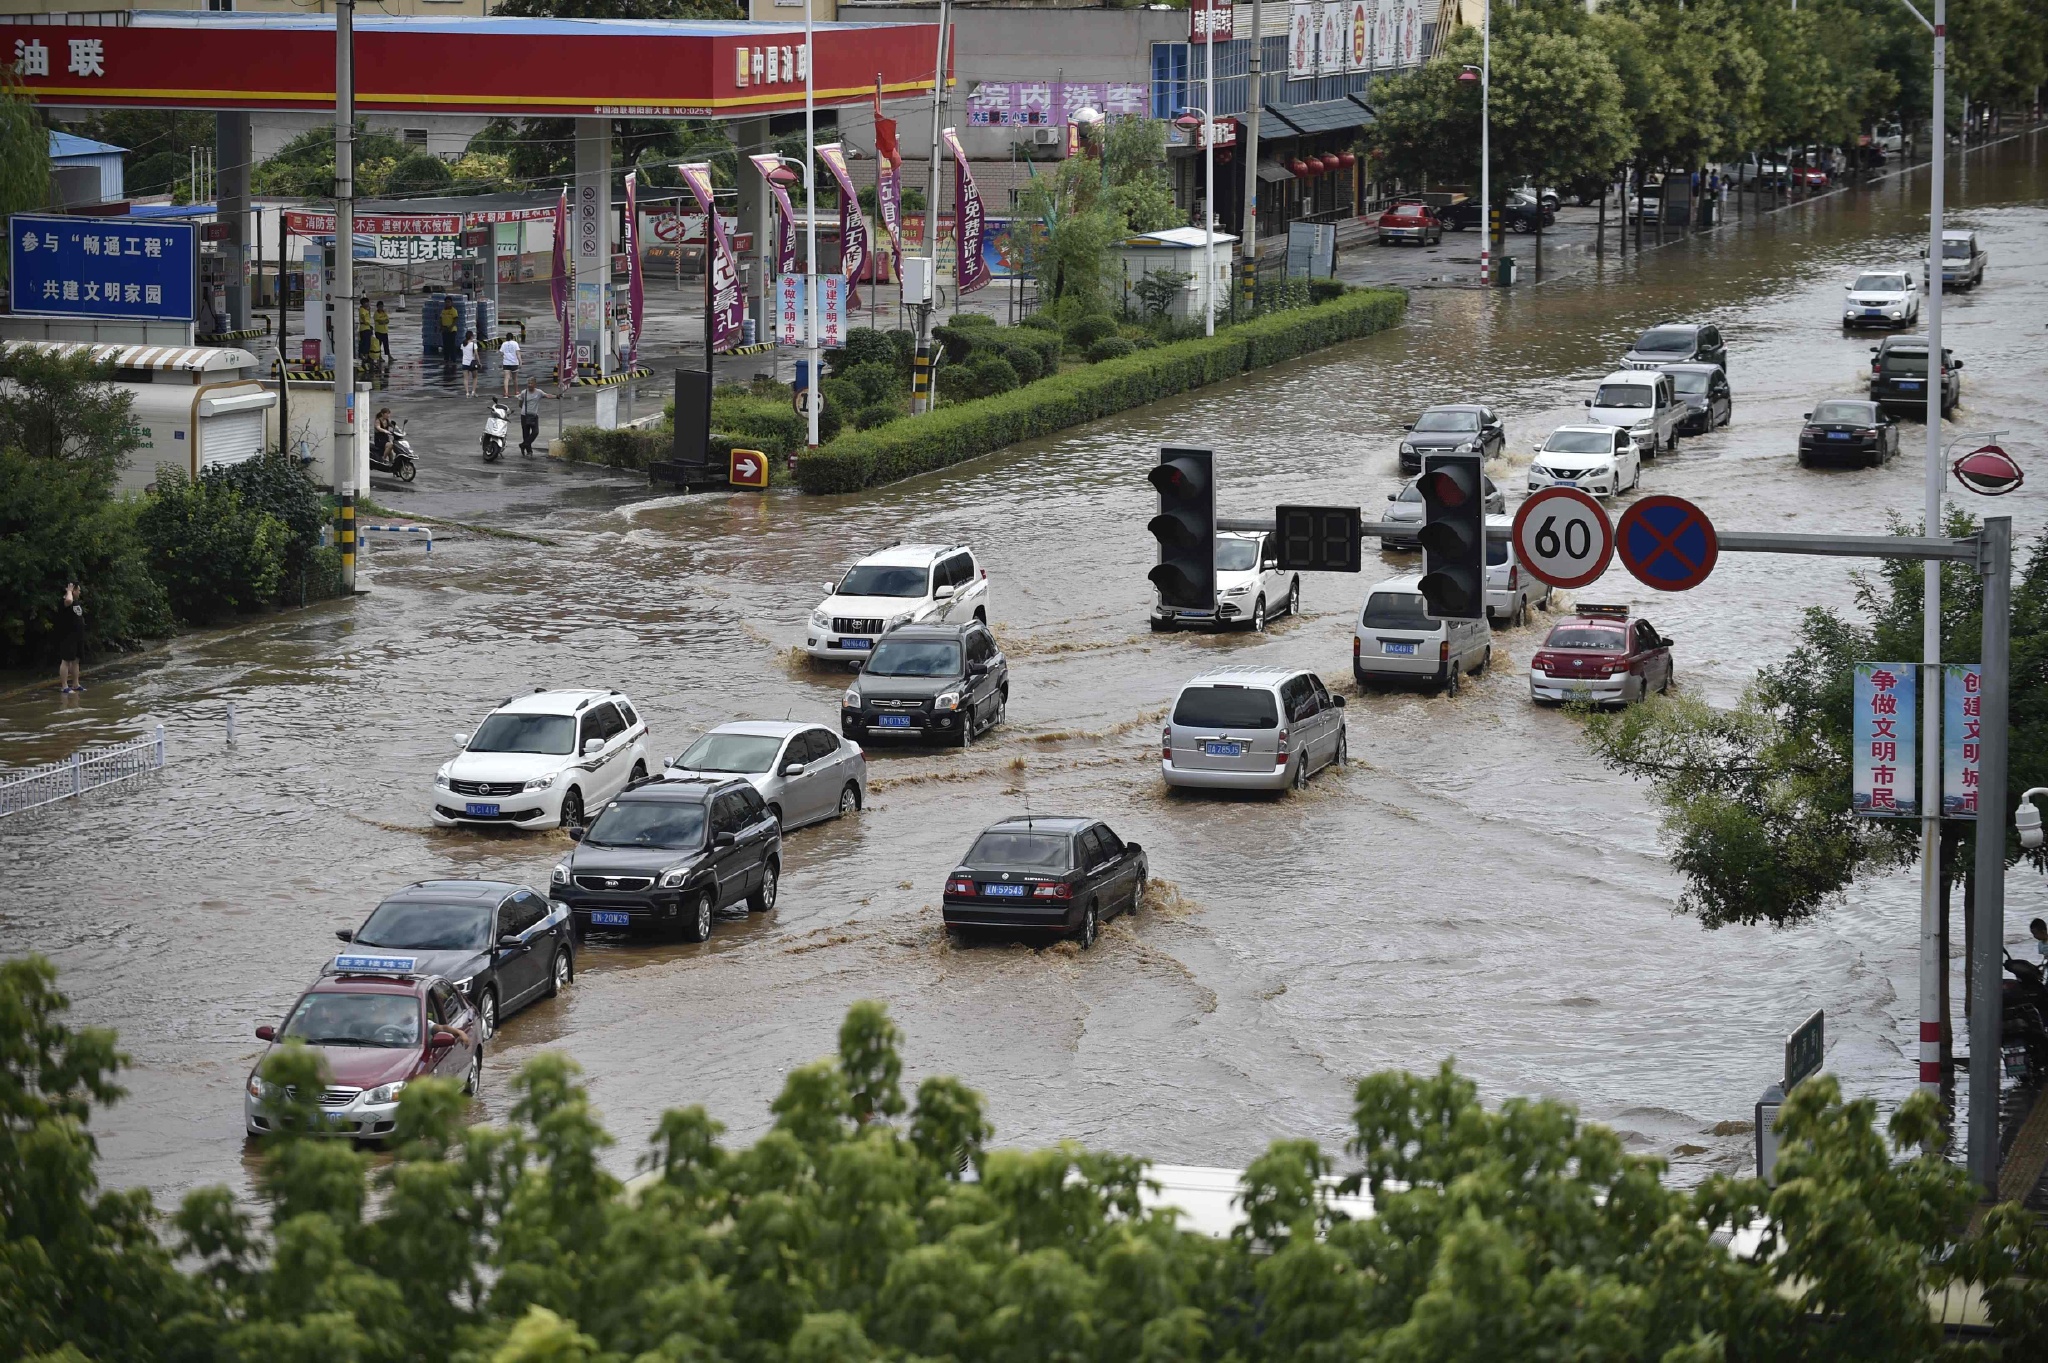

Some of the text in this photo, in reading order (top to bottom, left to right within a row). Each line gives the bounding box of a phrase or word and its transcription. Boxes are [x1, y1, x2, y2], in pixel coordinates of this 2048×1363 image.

[14, 38, 105, 77] 油联
[974, 84, 1143, 111] 院内洗车
[22, 231, 174, 258] 参与“畅通工程”
[305, 216, 454, 234] 消防常不忘 遇到火情不惊慌
[42, 279, 163, 305] 共建文明家园
[783, 277, 797, 345] 争做文明市民
[825, 278, 838, 346] 创建文明城市
[1535, 516, 1591, 560] 60
[1870, 669, 1898, 809] 争做文明市民
